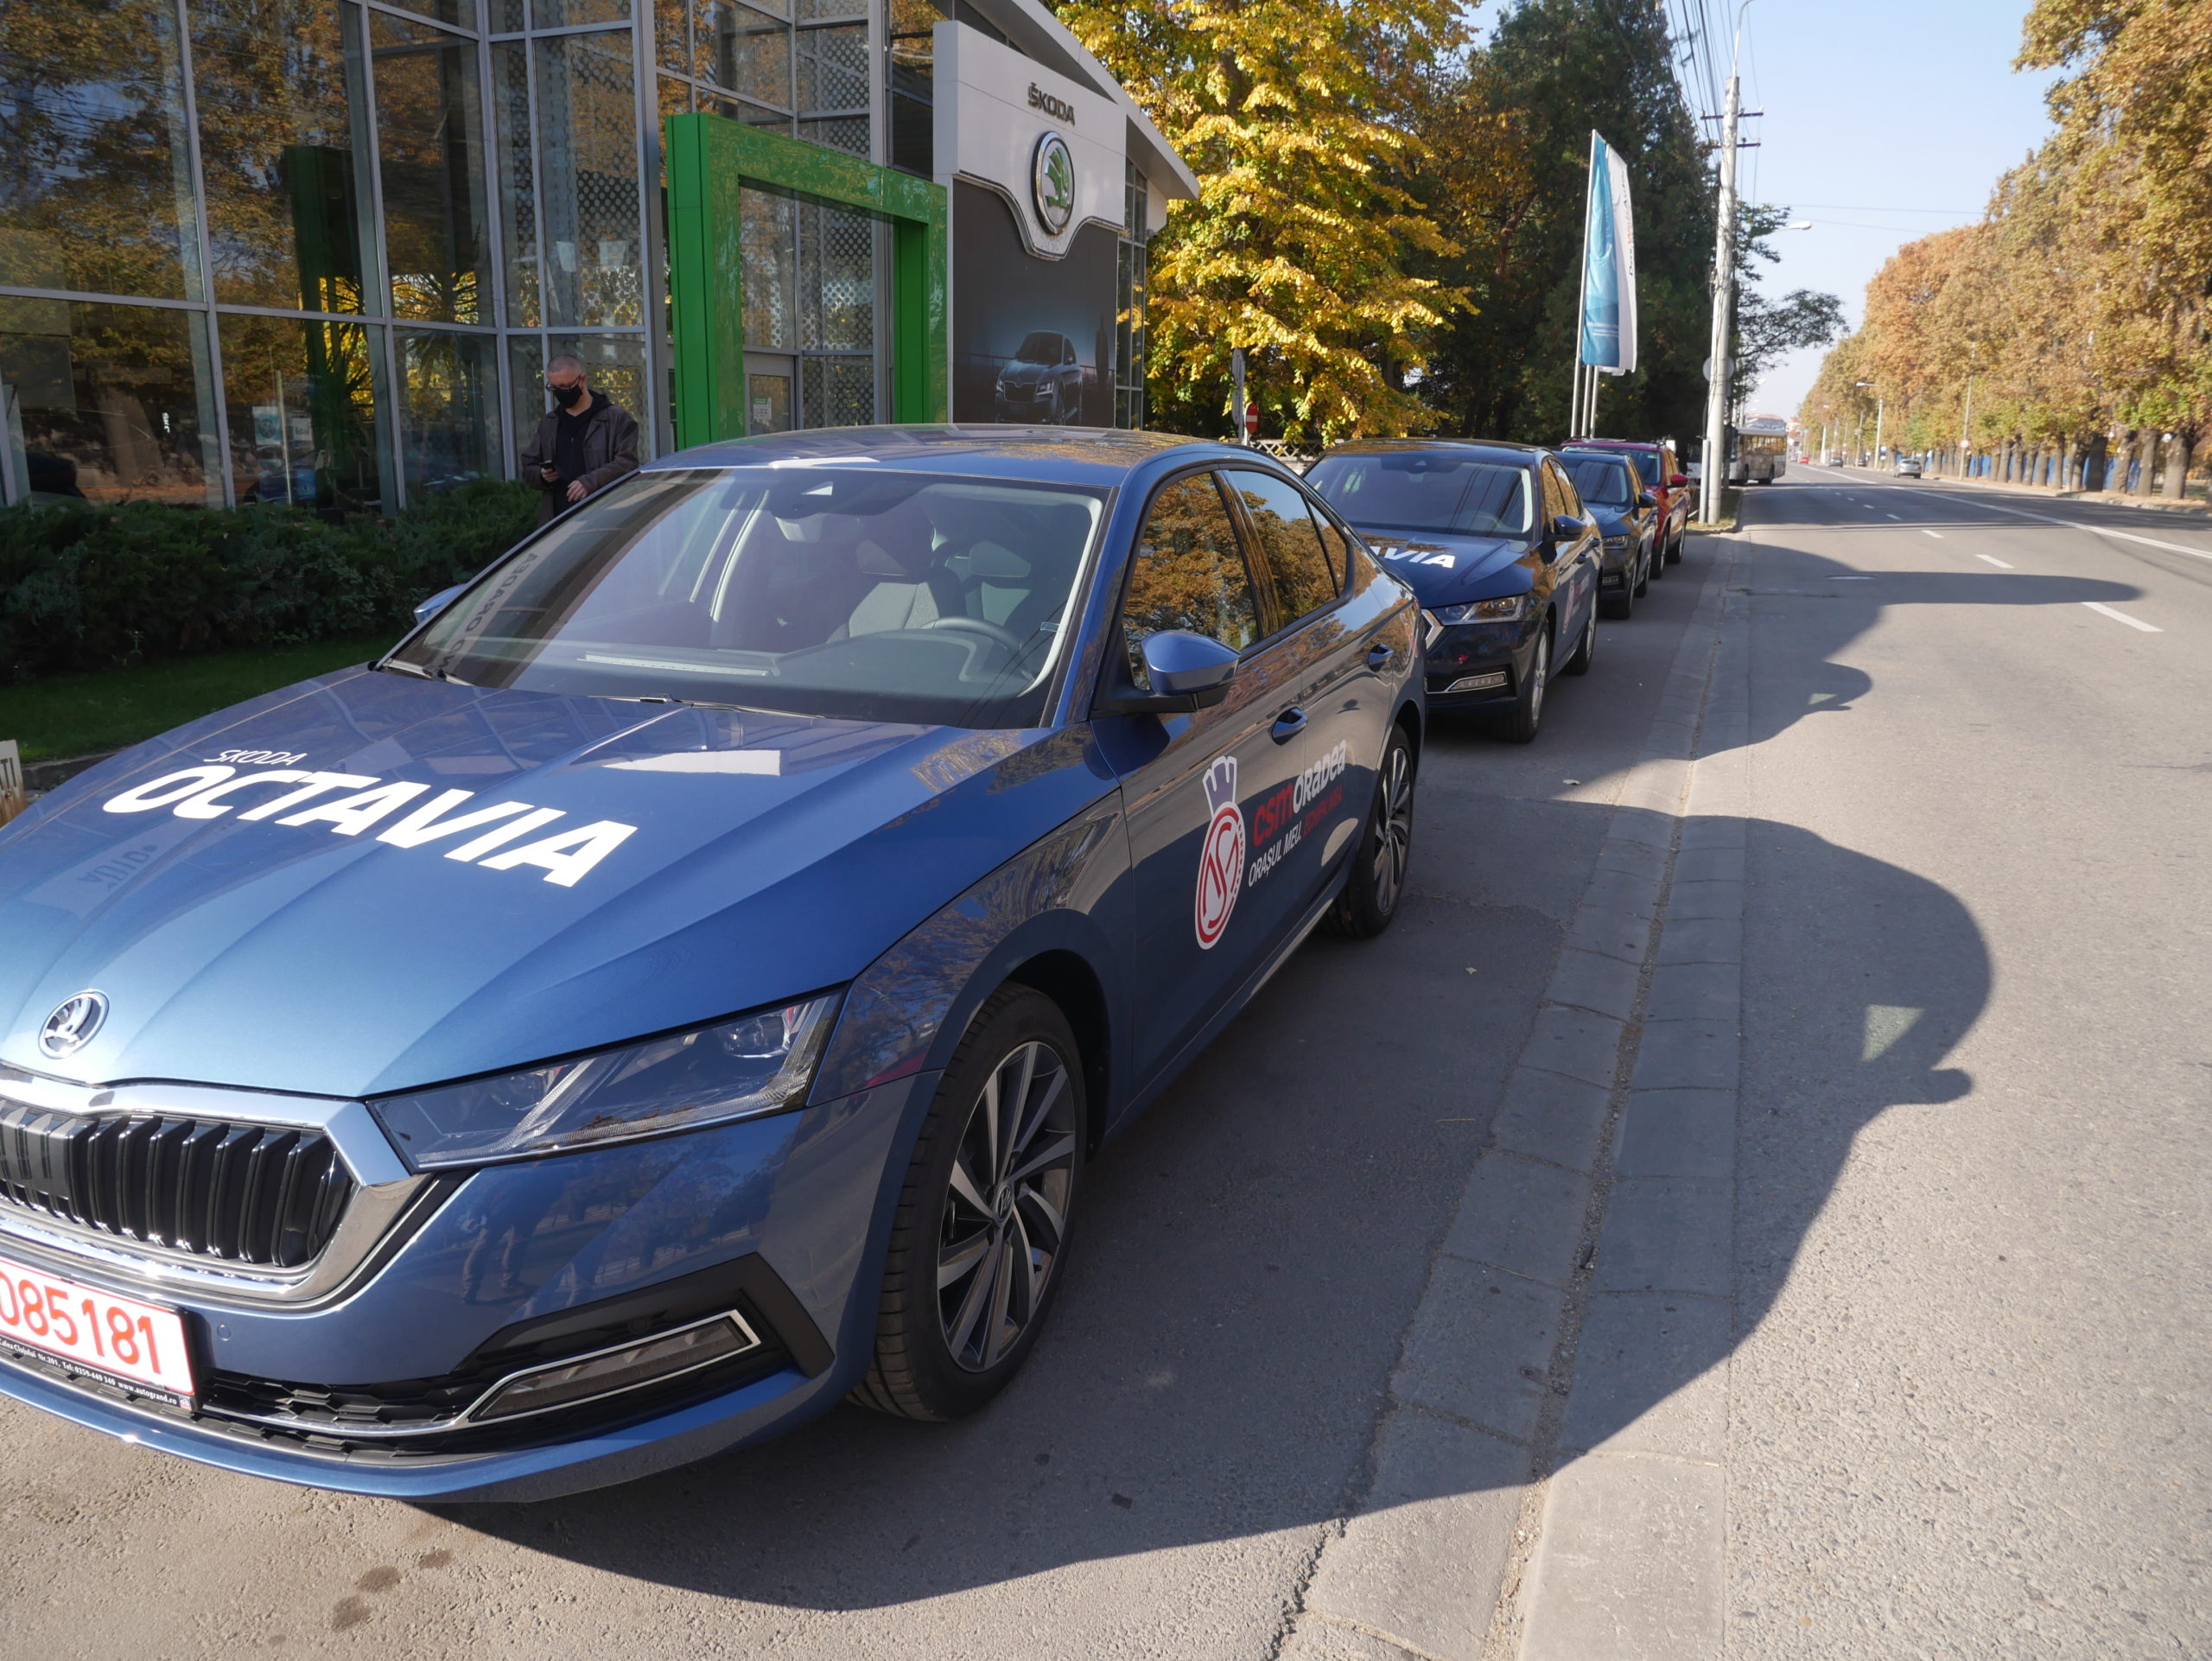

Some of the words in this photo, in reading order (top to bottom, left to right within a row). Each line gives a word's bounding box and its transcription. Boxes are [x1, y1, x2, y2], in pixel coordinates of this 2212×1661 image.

[1027, 81, 1076, 126] ŠKODA
[103, 766, 638, 888] OCTAVIA
[1283, 820, 1302, 856] MEU.
[118, 1381, 177, 1405] www.autogrand.ro
